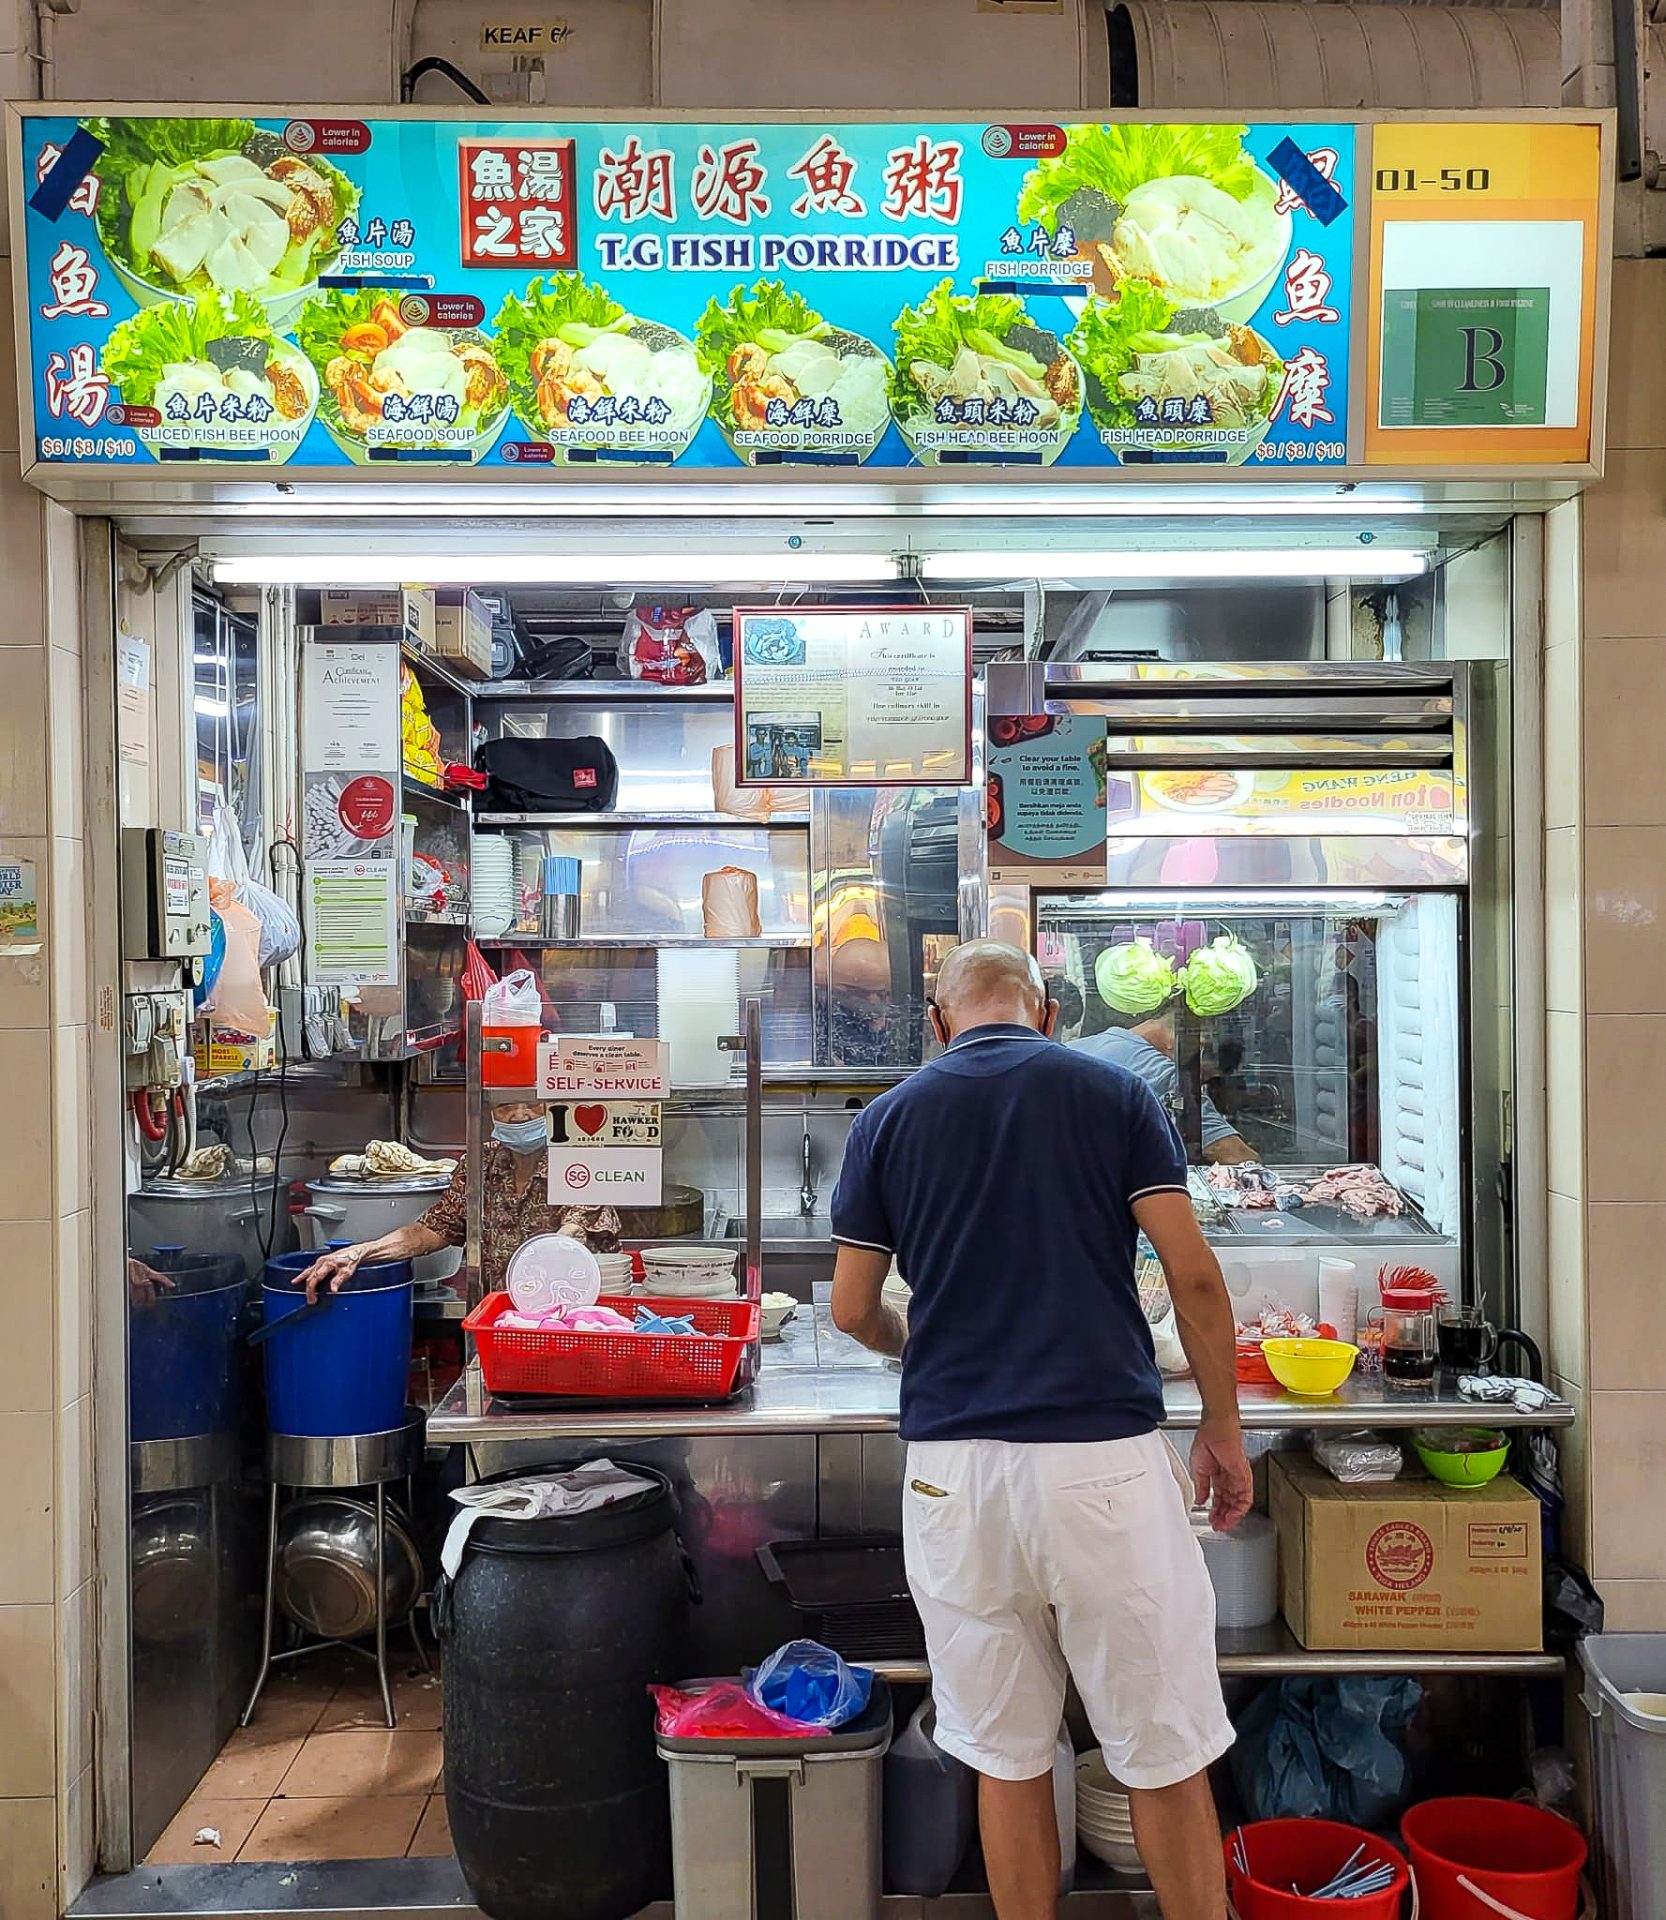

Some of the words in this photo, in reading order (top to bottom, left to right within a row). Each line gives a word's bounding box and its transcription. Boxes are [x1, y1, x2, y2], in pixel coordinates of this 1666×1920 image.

[484, 27, 543, 44] KEAF
[322, 127, 350, 137] Lower
[351, 127, 360, 137] in
[1018, 132, 1047, 141] Lower
[1047, 132, 1056, 141] in
[322, 137, 360, 146] calories
[1018, 142, 1056, 150] calories
[471, 150, 564, 201] 魚湯
[598, 136, 962, 221] 潮源魚粥
[1375, 168, 1490, 192] 01-50
[337, 217, 415, 248] 魚片湯
[473, 205, 566, 258] 之家
[600, 238, 659, 266] T.G
[672, 238, 752, 267] FISH
[764, 238, 957, 267] PORRIDGE
[340, 254, 370, 266] FISH
[374, 254, 413, 267] SOUP
[987, 263, 1016, 275] FISH
[1021, 263, 1091, 275] PORRIDGE
[437, 301, 464, 311] Lower
[465, 302, 474, 311] in
[437, 311, 474, 320] calories
[1456, 327, 1507, 393] B
[167, 393, 274, 423] 魚片米粉
[383, 394, 459, 424] 海鮮湯
[567, 396, 672, 425] 海鮮米粉
[936, 398, 1039, 425] 魚頭米粉
[141, 428, 191, 441] SLICED
[194, 429, 225, 441] FISH
[230, 429, 256, 441] BEE
[260, 430, 301, 442] HOON
[368, 429, 434, 441] SEAFOOD
[437, 429, 475, 441] SOUP
[551, 430, 616, 442] SEAFOOD
[619, 431, 646, 443] BEE
[650, 431, 690, 443] HOON
[735, 432, 799, 445] SEAFOOD
[803, 433, 874, 445] PORRIDGE
[915, 432, 944, 444] FISH
[948, 432, 986, 444] HEAD
[990, 432, 1016, 444] BEE
[1019, 432, 1058, 444] HOON
[1102, 431, 1132, 442] FISH
[1136, 431, 1172, 442] HEAD
[1176, 431, 1246, 442] PORRIDGE
[859, 619, 955, 639] AWARD
[1062, 763, 1080, 771] fine.
[546, 1077, 661, 1090] SELF-SERVICE
[549, 1105, 570, 1143] I
[613, 1117, 659, 1125] HAWKER
[613, 1126, 659, 1138] FOOD
[568, 1170, 588, 1182] SG
[595, 1171, 645, 1182] CLEAN
[1348, 1592, 1407, 1601] SARAWAK
[1355, 1606, 1393, 1615] WHITE
[1396, 1606, 1441, 1616] PEPPER
